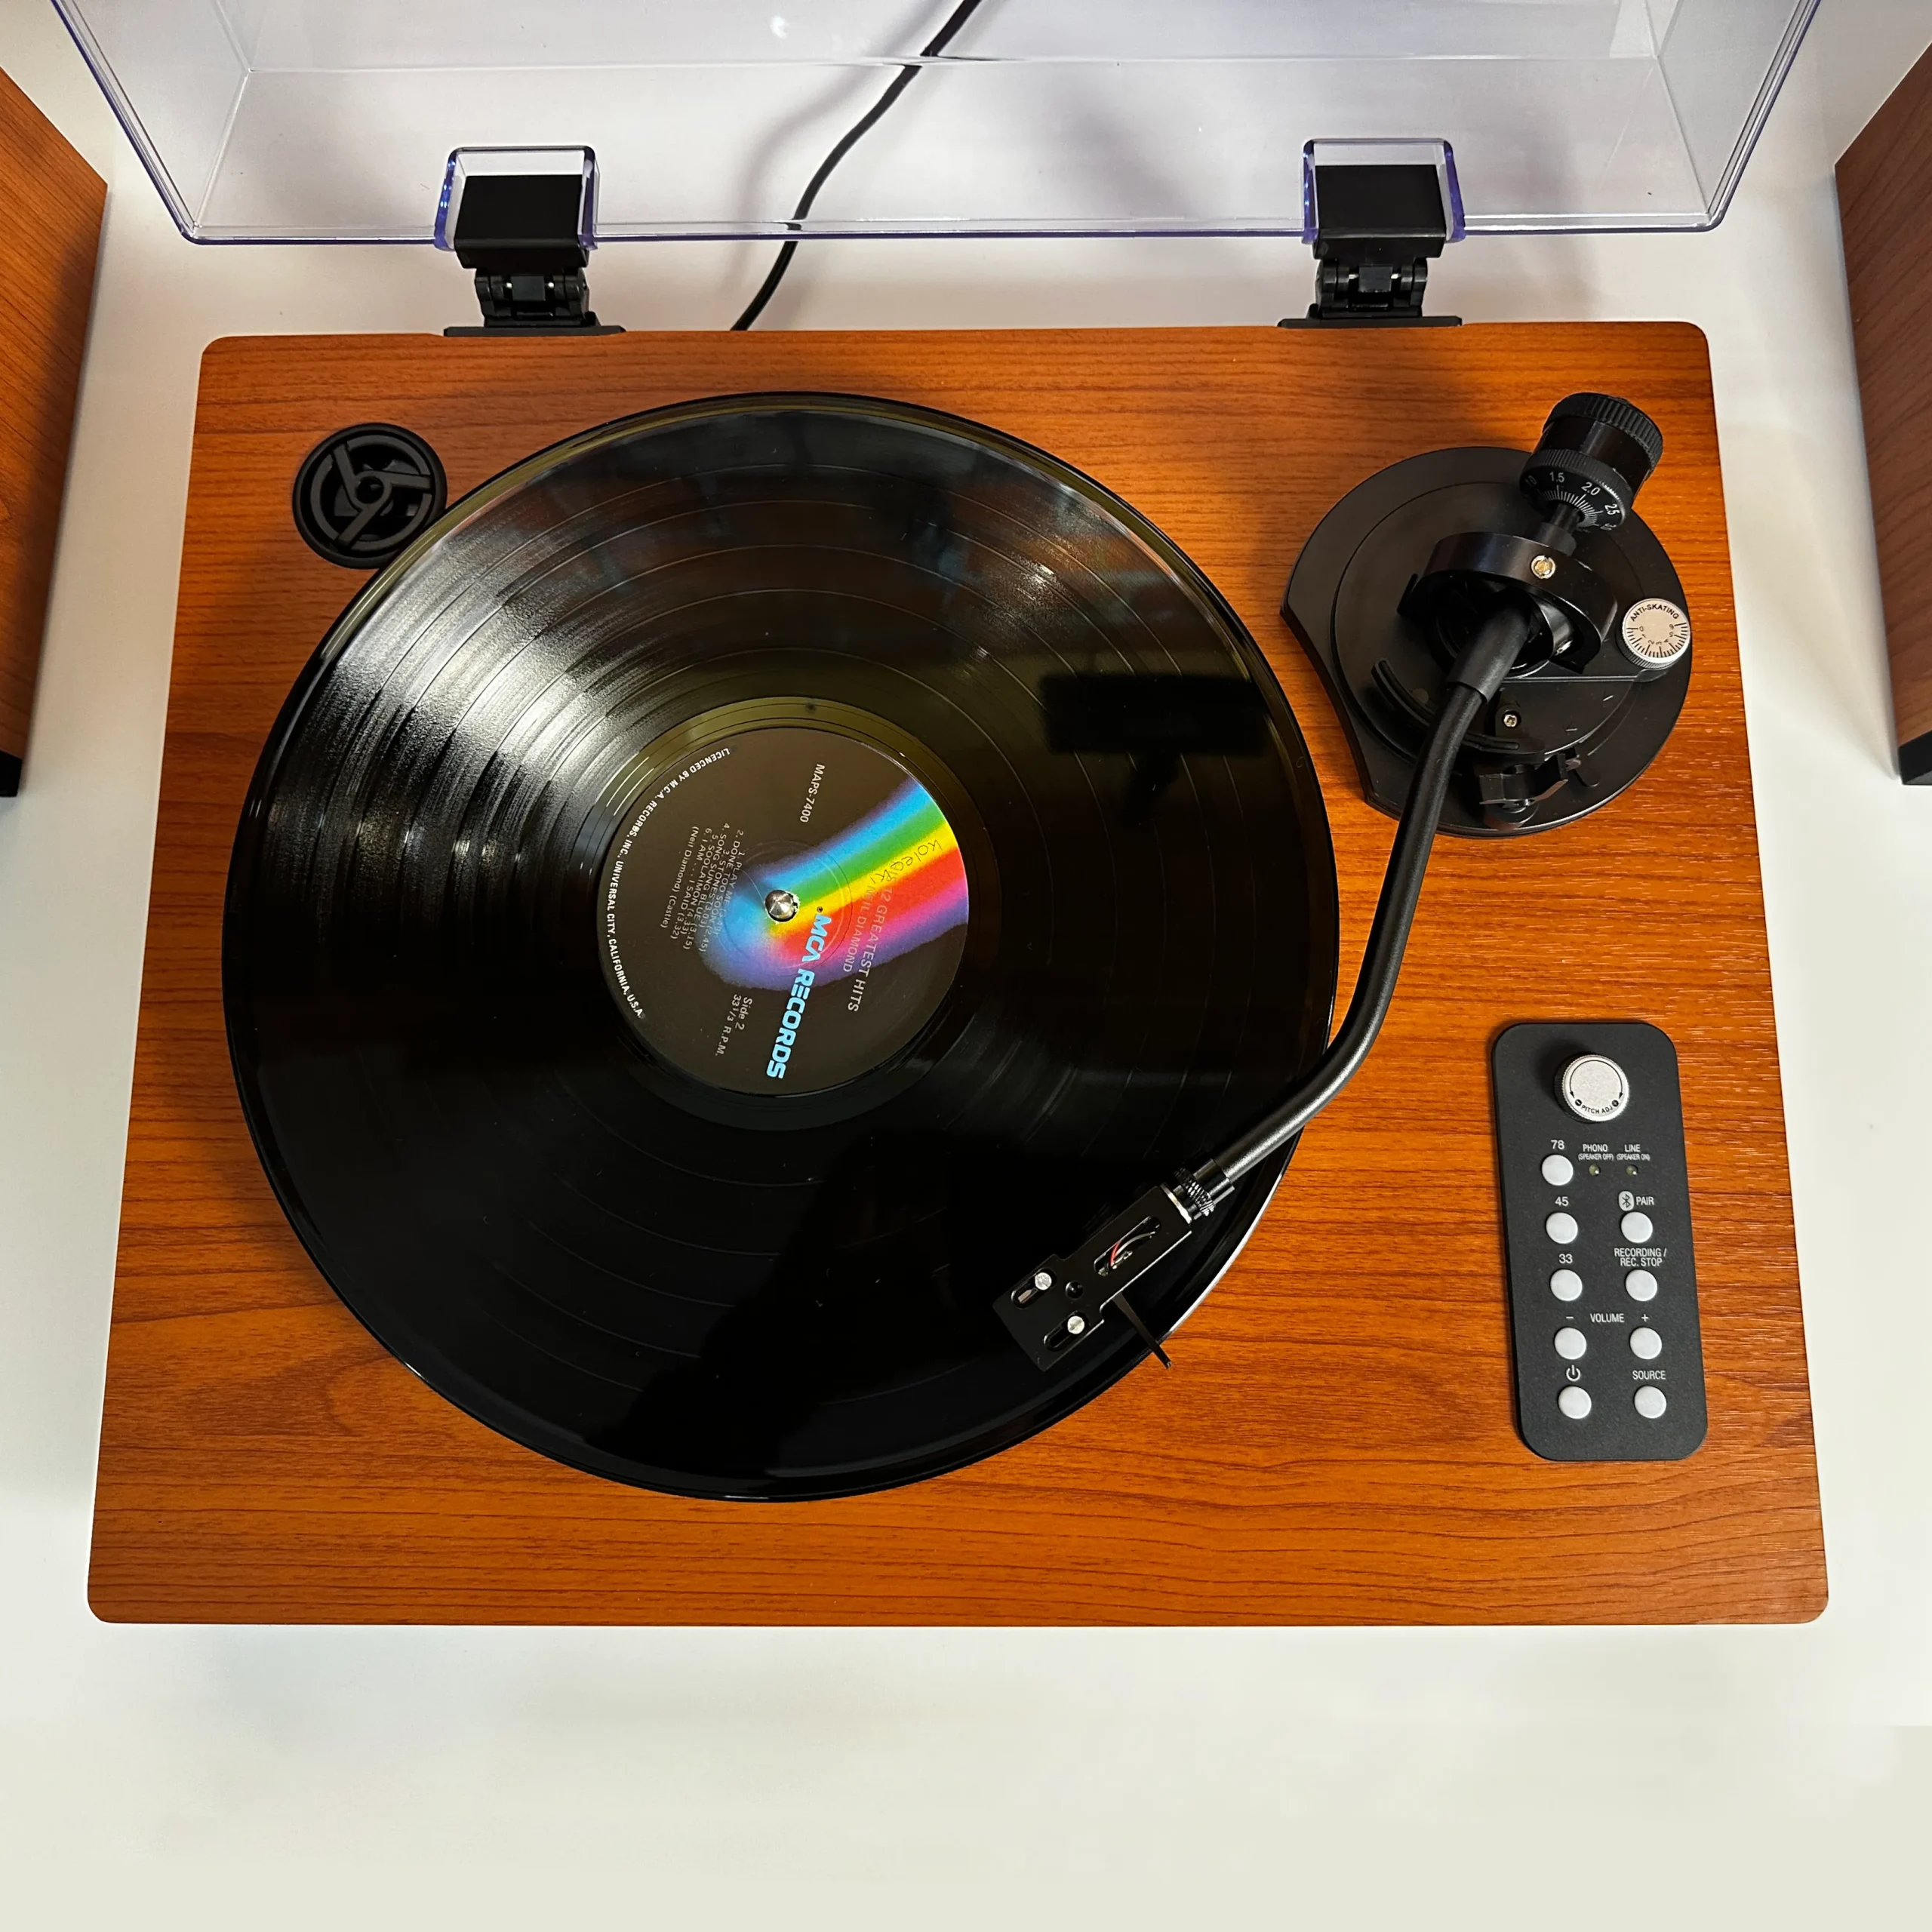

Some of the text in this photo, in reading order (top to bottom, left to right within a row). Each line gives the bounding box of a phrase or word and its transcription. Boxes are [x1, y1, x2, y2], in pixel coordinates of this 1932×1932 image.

[1549, 472, 1564, 483] 1.5
[1581, 481, 1601, 496] 2.0
[1630, 604, 1679, 622] ANTI-SKATING
[690, 748, 731, 773] LICENCED
[655, 779, 678, 799] M.C.A.
[678, 771, 690, 782] BY
[799, 764, 826, 823] MAPS-7400
[696, 844, 706, 861] AM
[712, 833, 727, 861] SONG
[608, 861, 623, 911] UNIVERSAL
[660, 826, 700, 929] (Neil Diamond) (Castle)
[690, 844, 715, 906] SOOLAIMON
[703, 863, 718, 891] SUNG
[708, 860, 727, 900] STONES
[728, 861, 743, 889] PLAY
[680, 885, 694, 911] SAID
[698, 829, 744, 952] 2. DONE TOO SOON (2.45)
[693, 894, 708, 921] BLUE
[698, 900, 713, 928] (3.03)
[669, 912, 685, 940] (3.32)
[679, 908, 695, 935] (4.33)
[682, 922, 698, 950] (3.15)
[842, 916, 866, 973] DIAMOND
[858, 904, 888, 977] GREATEST
[608, 939, 631, 995] CALIFORNIA,
[765, 914, 832, 1078] MCA RECORDS
[847, 979, 866, 1013] HITS
[734, 996, 753, 1031] Side 2
[715, 1026, 732, 1057] R.P.M.
[1581, 1105, 1613, 1114] PITCH ADJ
[1551, 1140, 1564, 1149] 78
[1625, 1144, 1641, 1152] LINE
[1555, 1196, 1569, 1206] 45
[1636, 1196, 1654, 1205] PAIR
[1558, 1254, 1573, 1263] 33
[1614, 1247, 1661, 1257] RECORDING
[1620, 1257, 1663, 1266] REC. STOP
[1590, 1313, 1625, 1322] VOLUME
[1632, 1371, 1666, 1380] SOURCE
